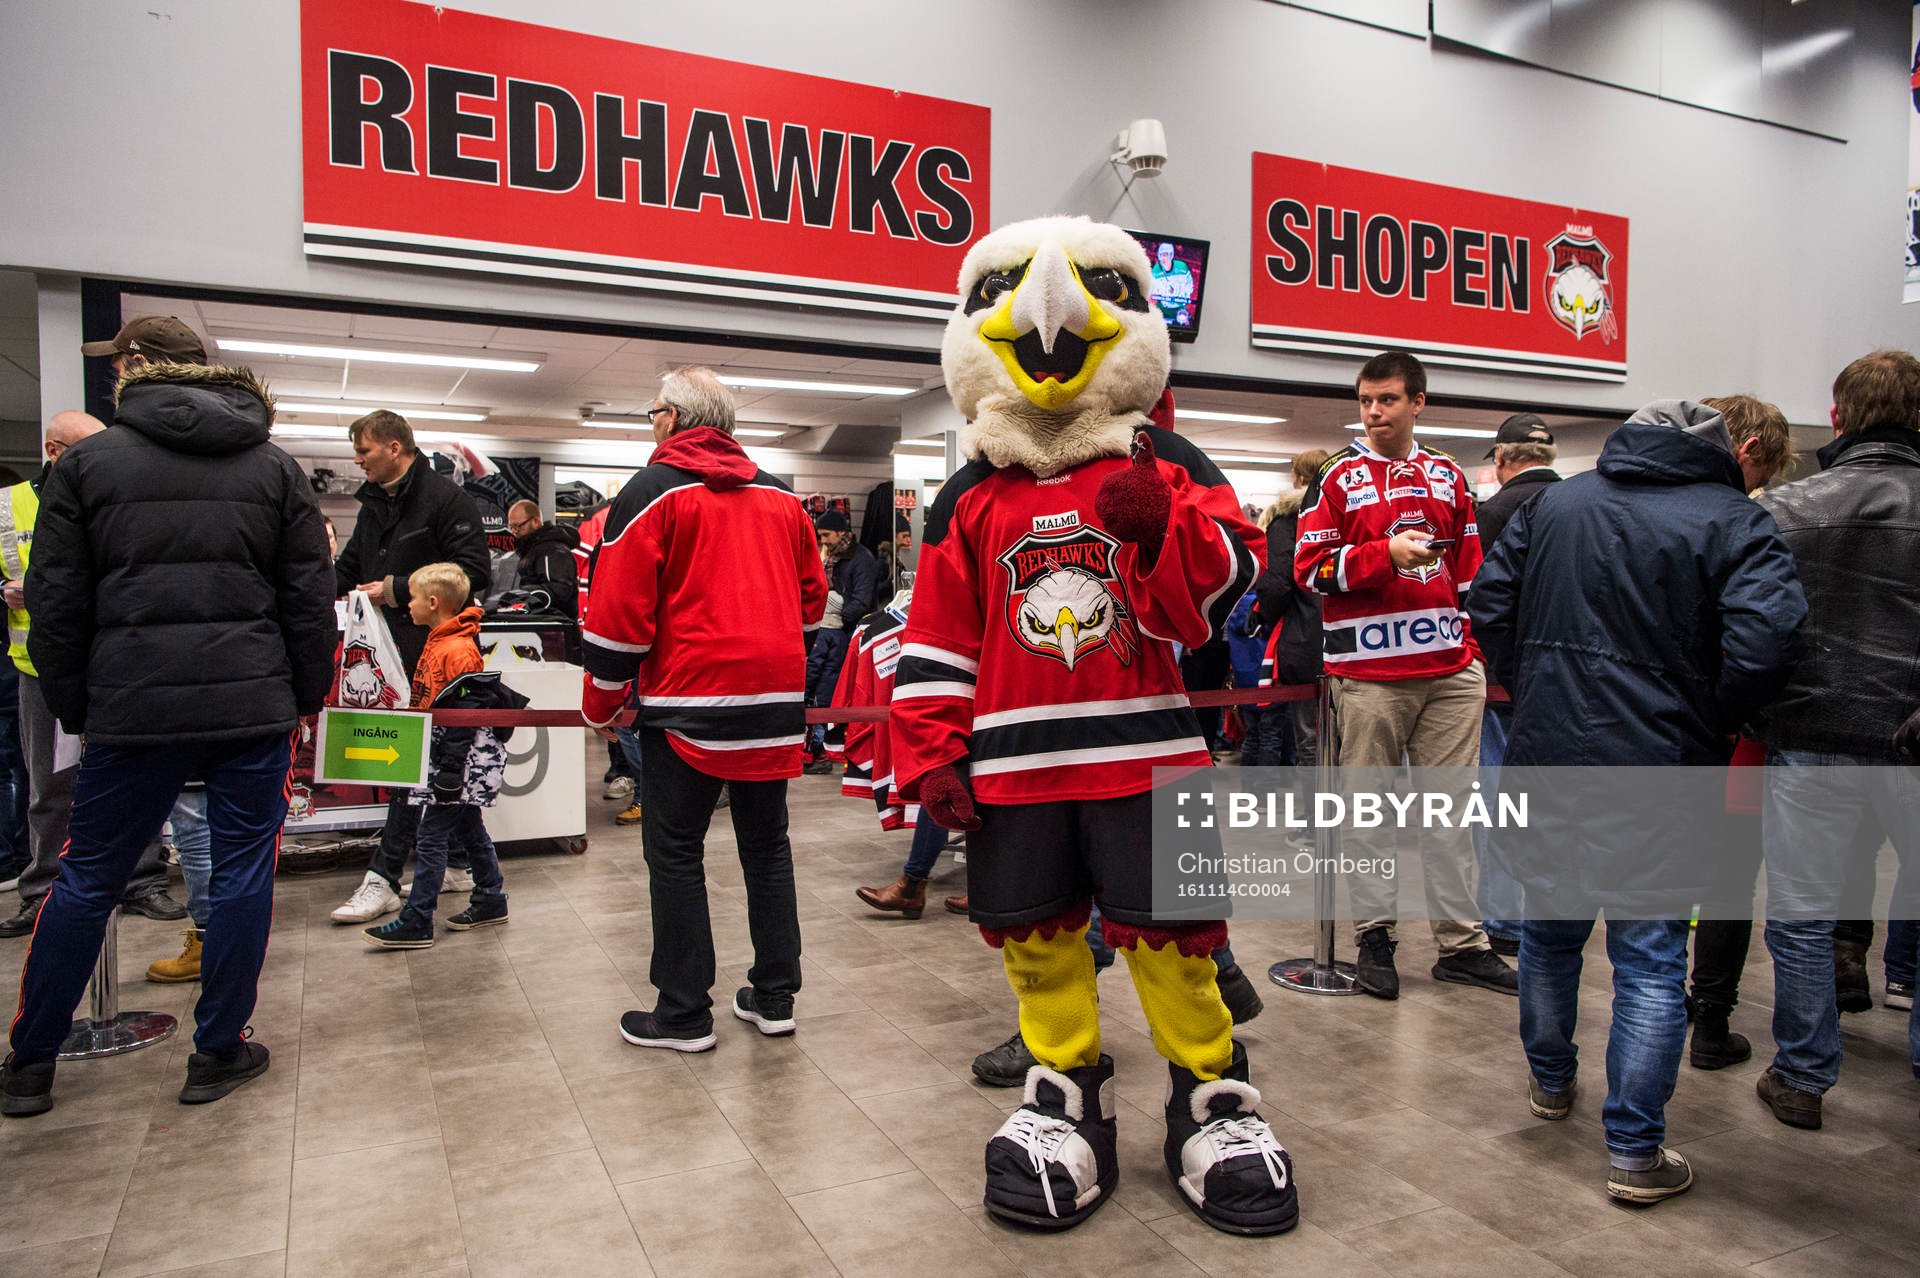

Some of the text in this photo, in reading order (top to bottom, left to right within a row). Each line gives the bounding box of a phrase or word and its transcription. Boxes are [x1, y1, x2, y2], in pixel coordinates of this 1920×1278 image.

[327, 47, 973, 246] REDHAWKS
[1266, 198, 1530, 314] SHOPEN
[1036, 475, 1072, 486] Reebok
[1035, 514, 1078, 531] MALMÖ
[1015, 542, 1106, 585] REDHAWKS
[353, 727, 398, 739] INGÅNG
